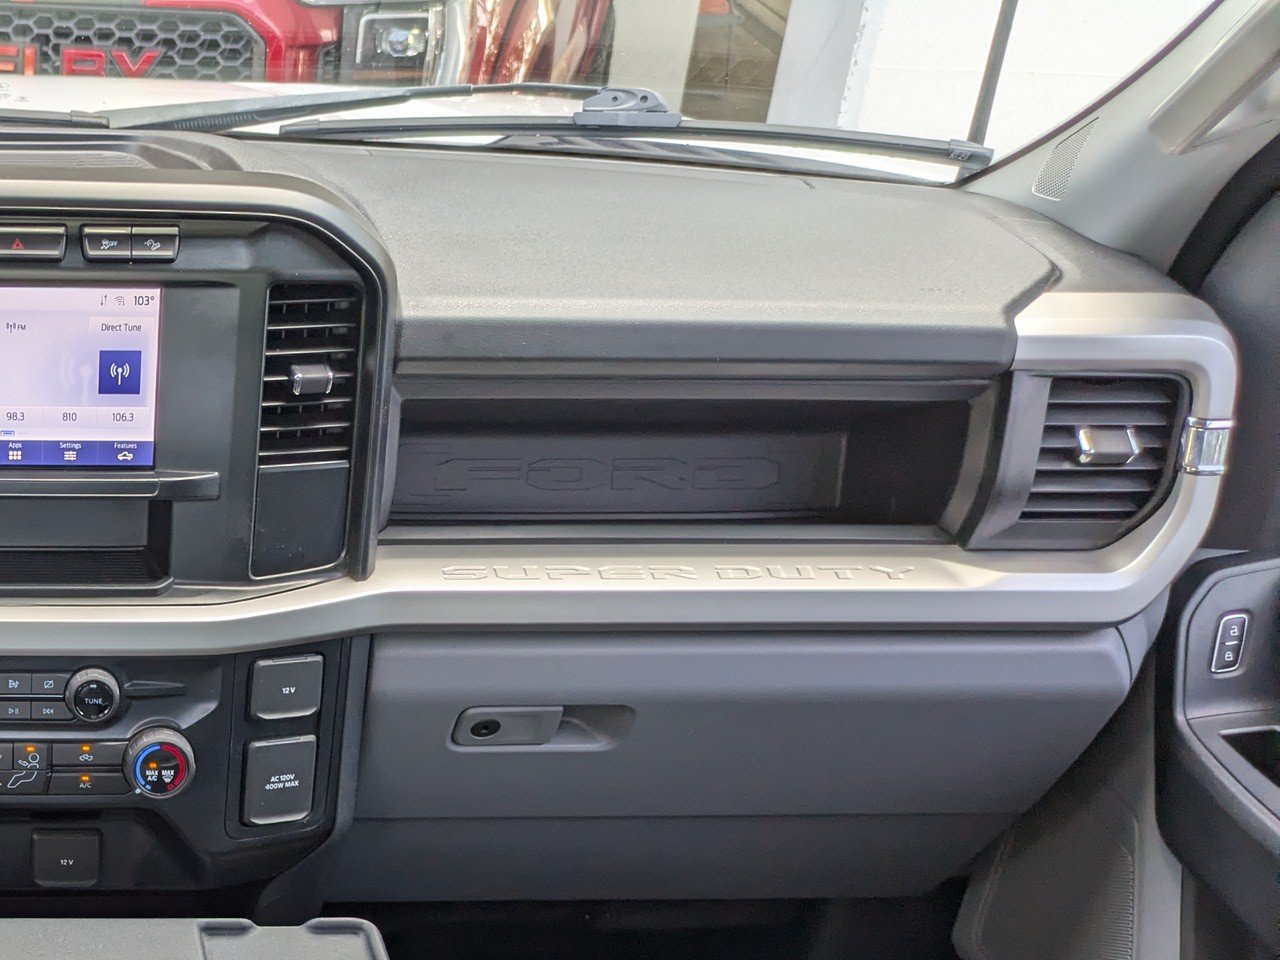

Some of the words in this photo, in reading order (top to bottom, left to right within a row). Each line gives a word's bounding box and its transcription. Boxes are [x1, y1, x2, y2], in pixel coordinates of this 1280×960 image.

[133, 295, 155, 306] 103°
[101, 323, 122, 332] Direct
[124, 323, 142, 332] Tune
[6, 411, 25, 421] 98.3
[62, 412, 77, 422] 810
[112, 412, 134, 422] 106.3
[8, 441, 23, 450] Apps
[60, 441, 81, 450] Settings
[435, 457, 781, 490] FORD
[442, 565, 697, 581] SUPER
[715, 565, 914, 581] DUTY
[280, 774, 295, 782] 120V
[265, 782, 284, 790] 400W
[284, 780, 299, 788] MAX
